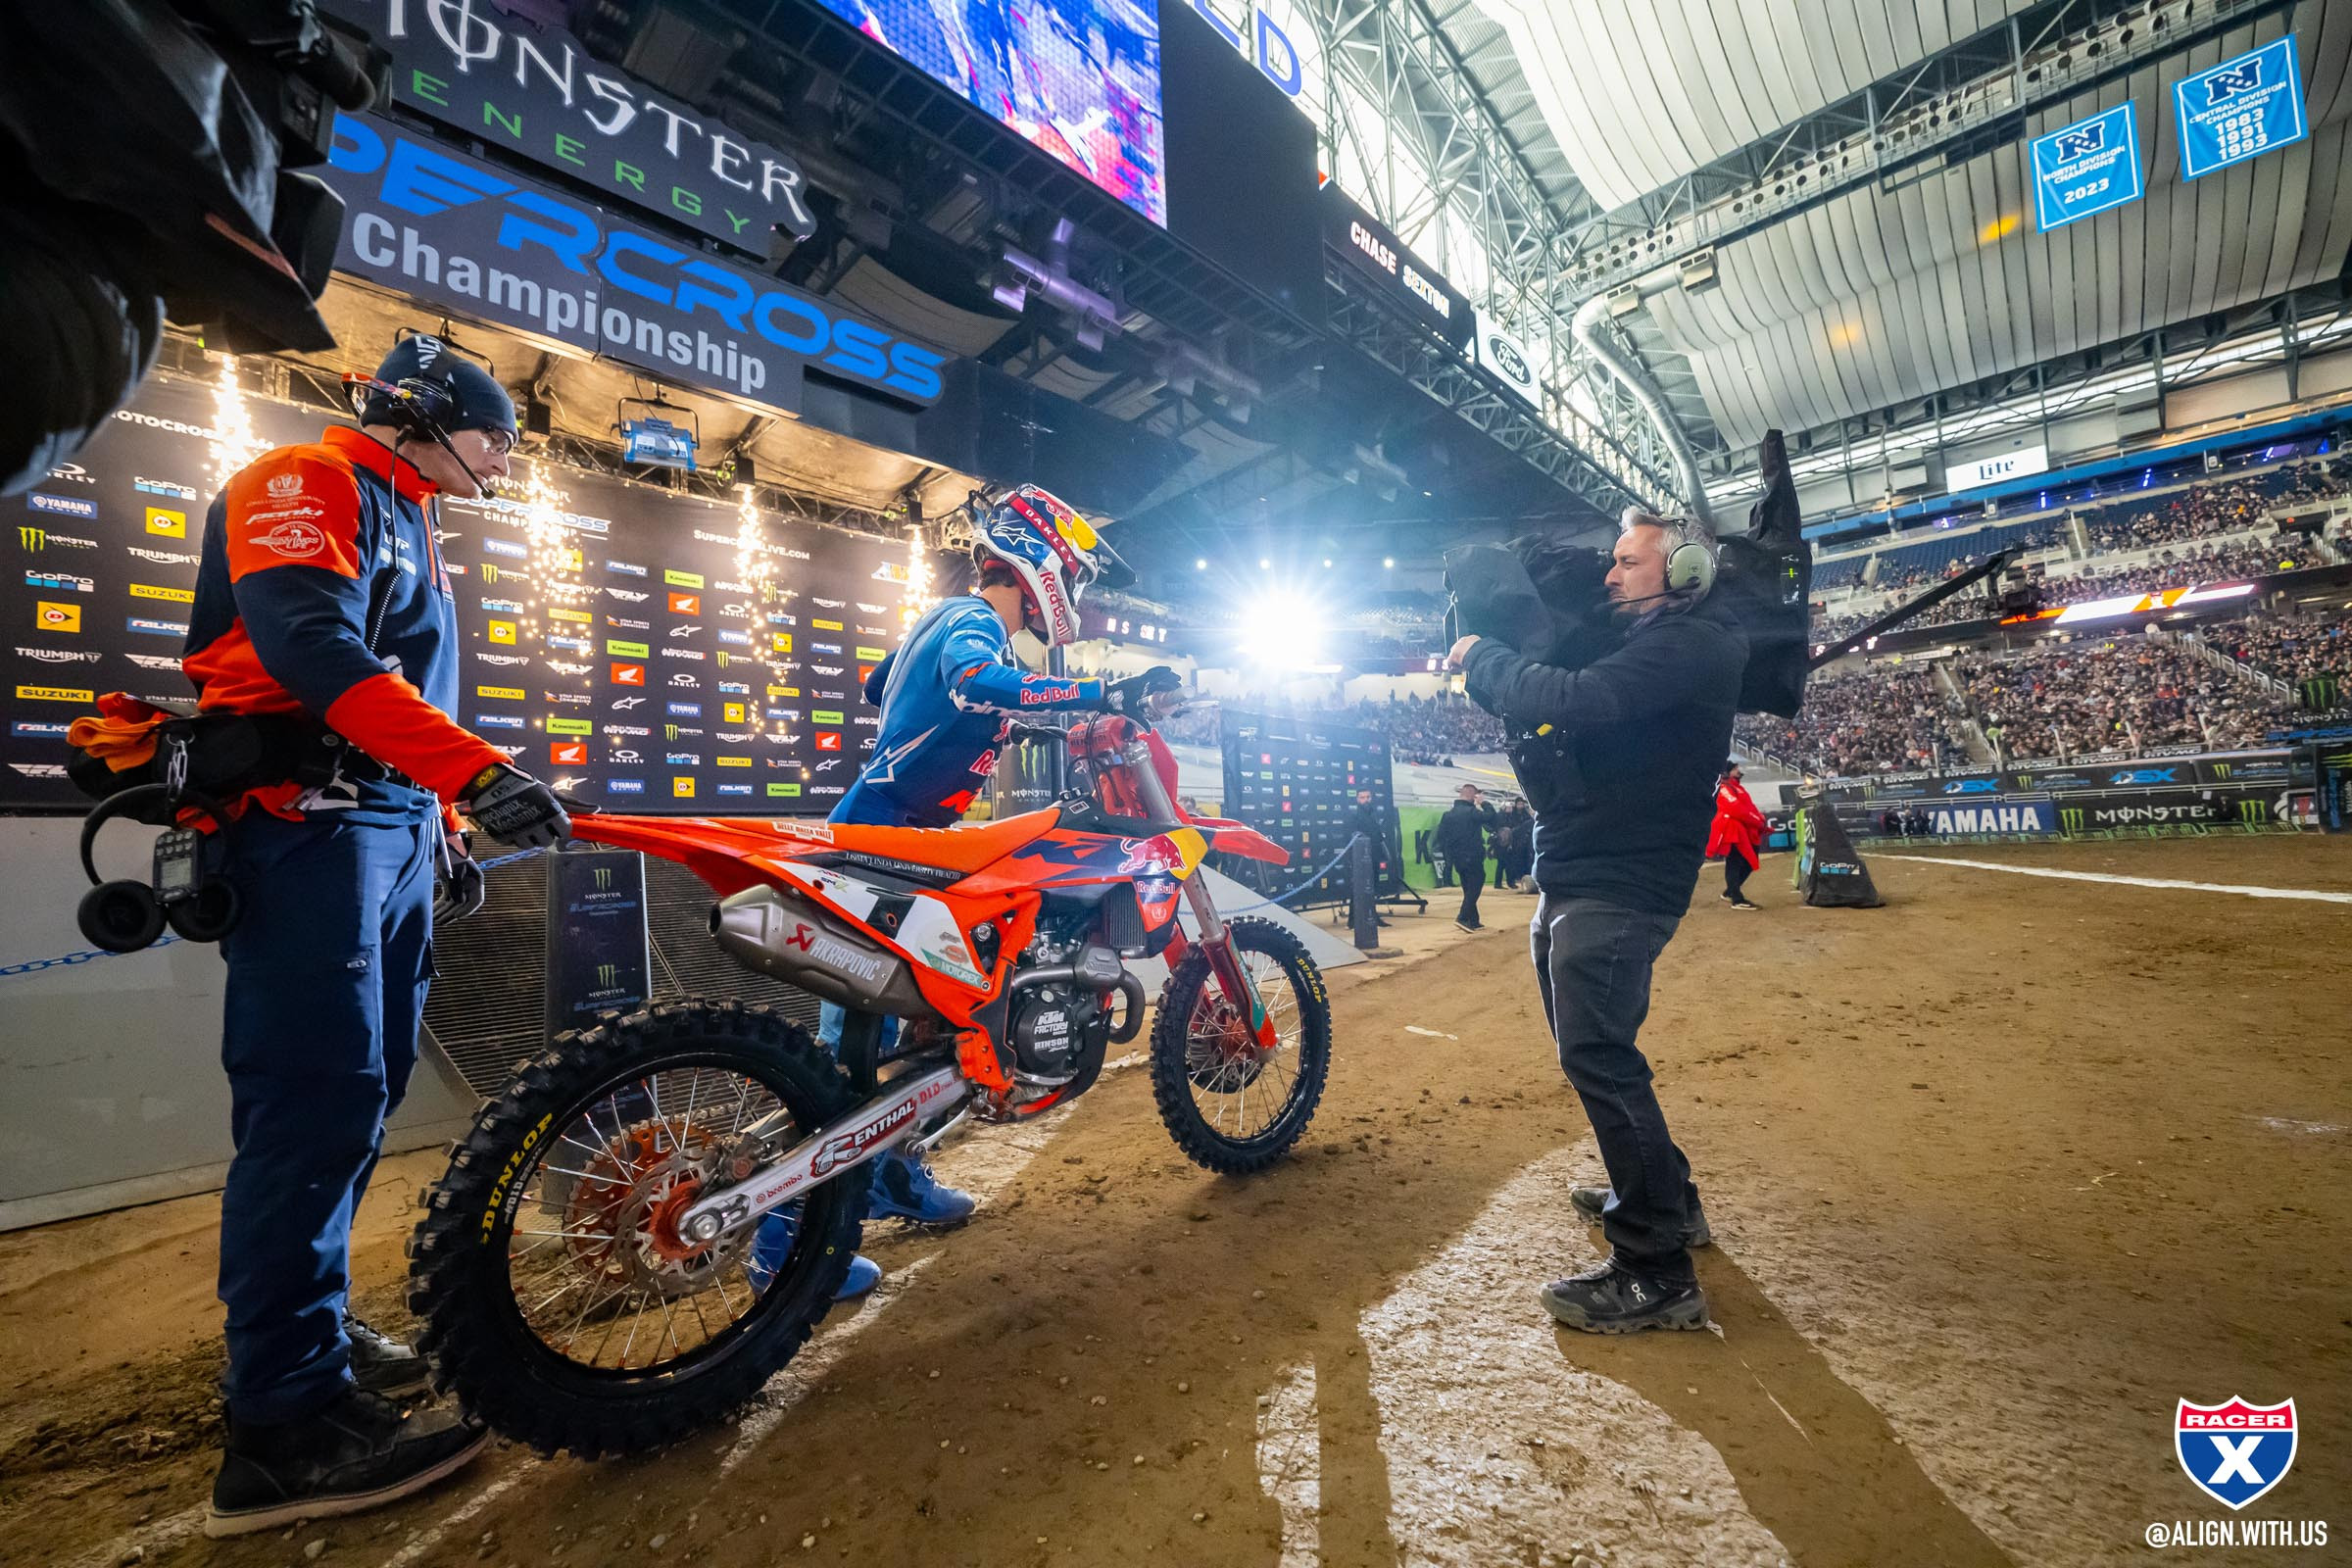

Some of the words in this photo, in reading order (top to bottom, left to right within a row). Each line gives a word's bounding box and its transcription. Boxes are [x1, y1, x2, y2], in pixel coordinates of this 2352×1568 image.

[2189, 102, 2236, 123] CENTRAL
[2238, 80, 2286, 105] DIVISION
[2206, 96, 2271, 124] CHAMPIONS
[2215, 108, 2264, 135] 1983
[2217, 122, 2264, 148] 1991
[412, 70, 751, 236] ENERGY
[2219, 133, 2268, 160] 1993
[2043, 163, 2078, 182] NORTH
[2079, 145, 2126, 168] DIVISION
[2054, 157, 2116, 184] CHAMPIONS
[2064, 177, 2110, 204] 2023
[327, 112, 948, 401] PERCROSS
[1350, 221, 1398, 275] CHASE
[1403, 265, 1451, 318] SEXTON
[352, 212, 766, 394] Championship
[1496, 340, 1526, 382] Ford
[111, 410, 218, 439] OTOCROS
[134, 476, 196, 494] GoPro
[47, 498, 93, 514] YAMAHA
[444, 493, 612, 533] SUPEROSS
[45, 534, 99, 548] MONSTER
[1025, 509, 1074, 564] OAKLEY
[127, 547, 191, 564] TRIUMPH
[25, 569, 95, 585] GoPro
[136, 587, 194, 600] SUZUKI
[481, 597, 523, 609] GoPro
[1039, 570, 1064, 608] Red
[1052, 601, 1071, 638] Bull
[15, 647, 85, 662] TRIUMPH
[476, 653, 519, 665] TRIUMPH
[23, 688, 88, 700] SUZUKI
[1020, 688, 1051, 706] Red
[1051, 684, 1081, 703] Bull
[479, 715, 524, 725] FALKEN
[2292, 712, 2352, 724] MONSTE
[1928, 807, 2041, 834] YAMAHA
[1138, 881, 1157, 893] Red
[1158, 882, 1176, 894] Bull
[809, 938, 882, 981] AKRAPOVIČ
[940, 962, 981, 986] MOTOREX
[1297, 956, 1322, 1004] DUNLOP
[1037, 1010, 1065, 1026] KTM
[482, 1113, 554, 1232] DUNLOP
[766, 1174, 804, 1200] brembo
